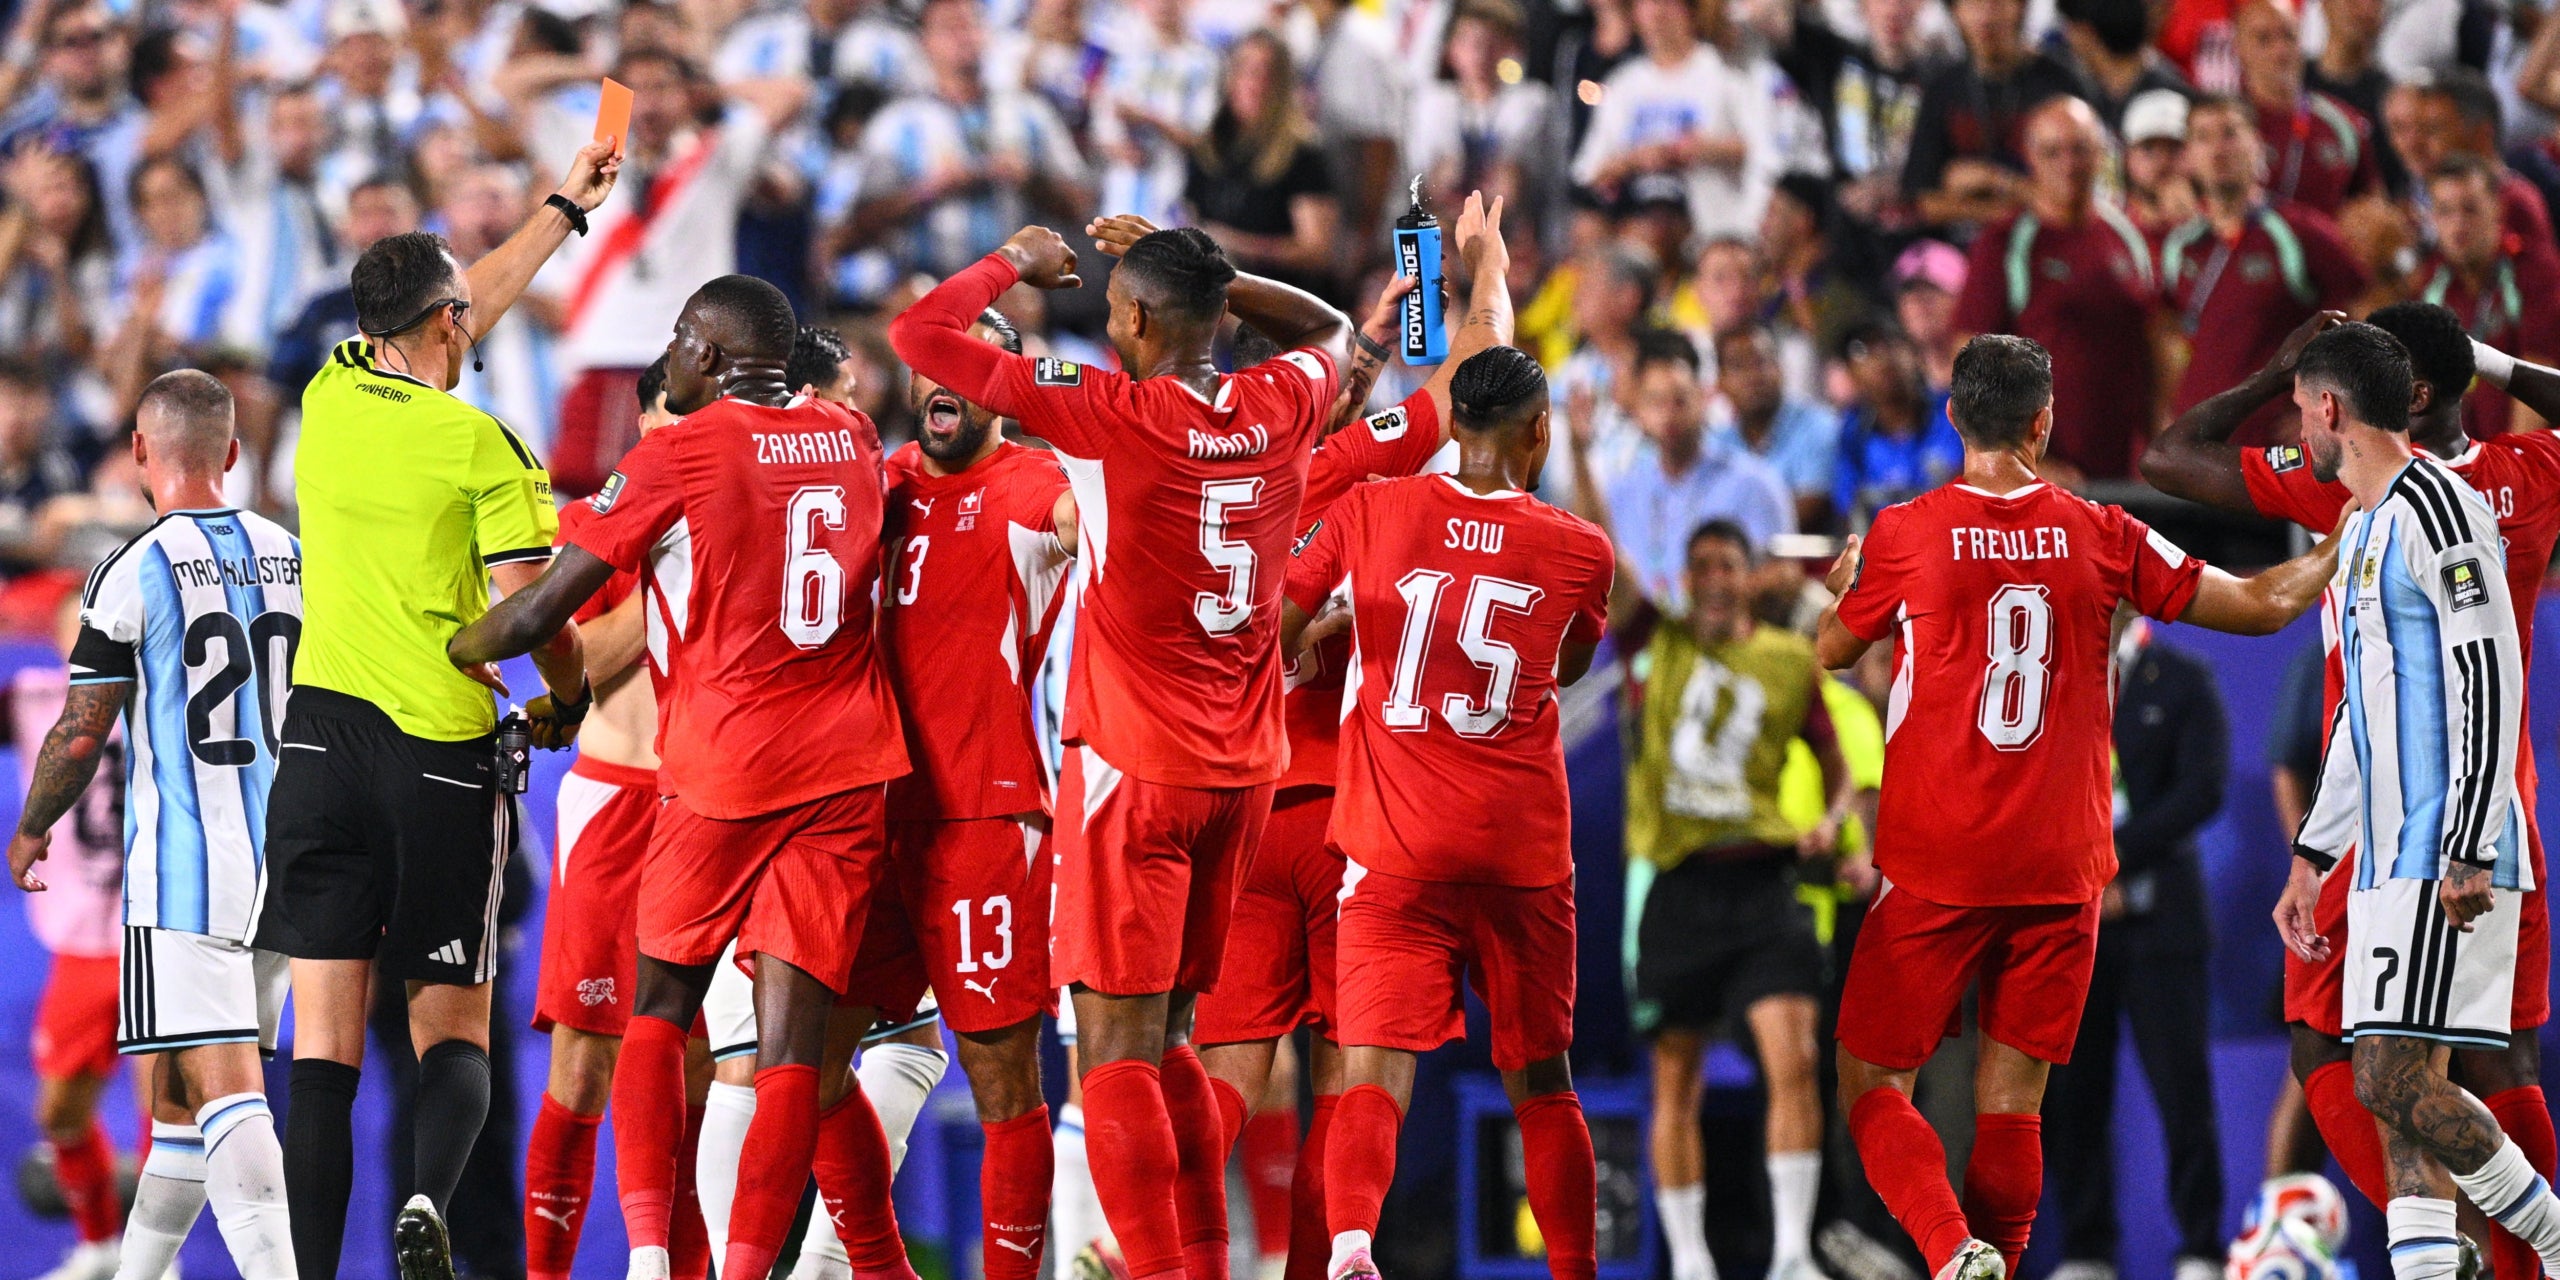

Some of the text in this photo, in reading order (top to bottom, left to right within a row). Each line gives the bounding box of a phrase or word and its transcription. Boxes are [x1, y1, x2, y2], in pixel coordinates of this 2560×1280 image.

[354, 383, 412, 404] PINHEIRO
[752, 429, 857, 464] ZAKARIA
[1188, 423, 1269, 459] AKANJI
[779, 485, 847, 650] 6
[1194, 476, 1266, 638] 5
[1444, 517, 1505, 554] SOW
[1951, 527, 2069, 561] FREULER
[172, 559, 222, 591] MAC
[1382, 568, 1546, 739] 15
[1977, 583, 2054, 752] 8
[181, 611, 303, 767] 20
[951, 894, 1013, 973] 13
[2372, 946, 2400, 1012] 7
